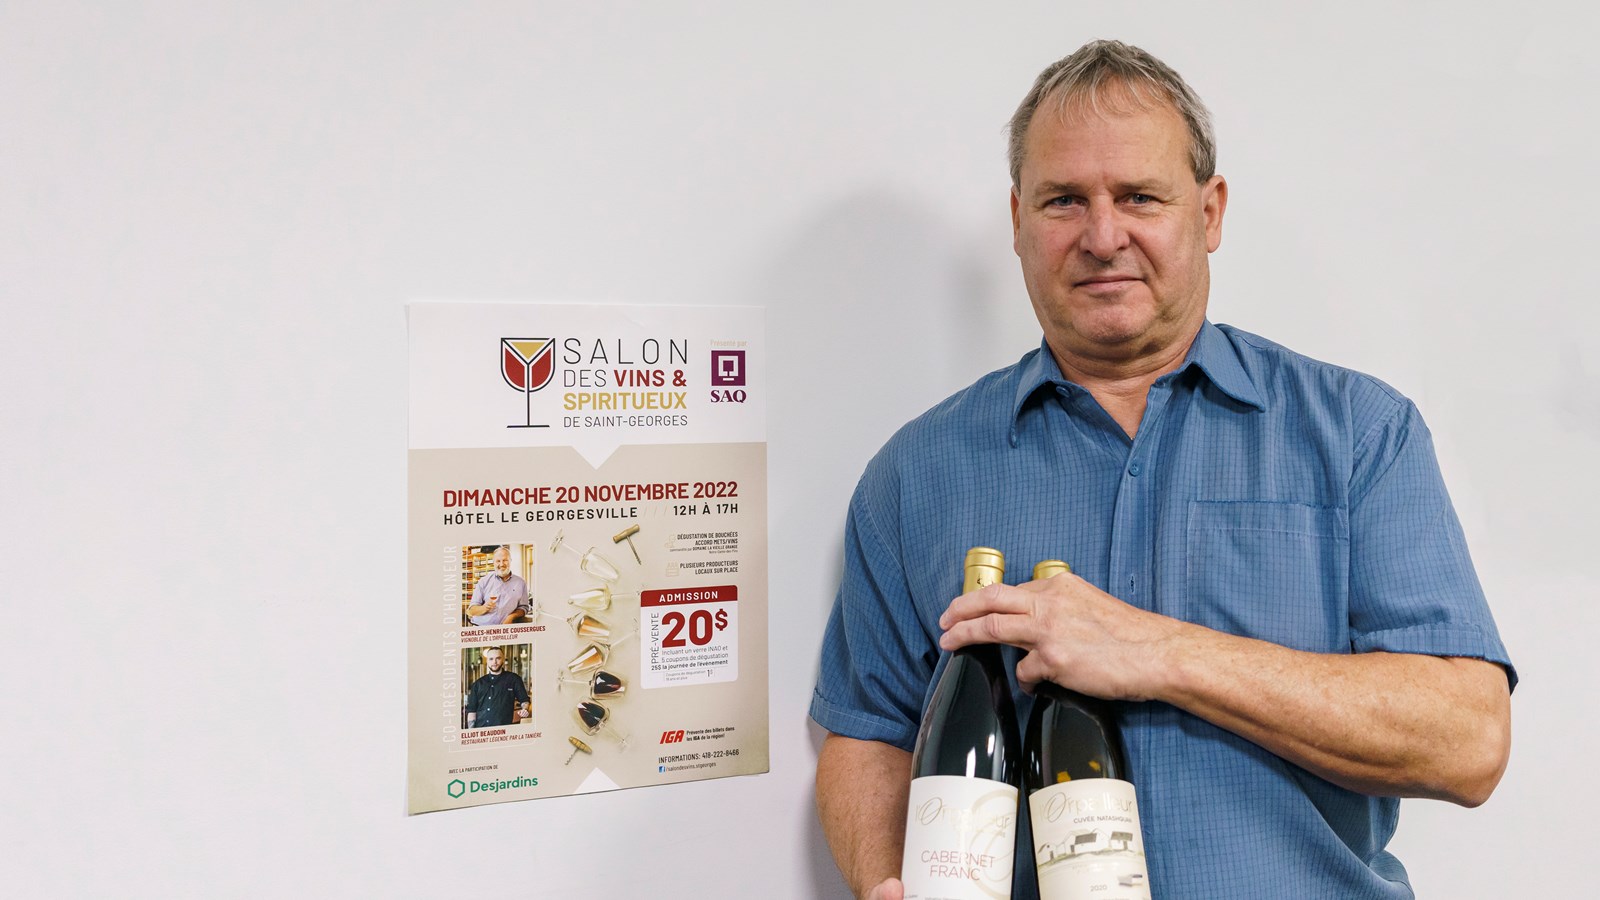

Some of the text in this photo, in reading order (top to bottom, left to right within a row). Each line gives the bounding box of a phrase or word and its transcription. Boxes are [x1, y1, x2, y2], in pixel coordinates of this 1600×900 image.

[563, 337, 688, 365] SALON
[710, 339, 747, 348] Présenté par
[563, 369, 687, 388] DES VINS &
[563, 391, 688, 411] SPIRITUEUX
[710, 389, 747, 404] SAQ
[563, 414, 688, 428] DE SAINT-GEORGES
[443, 481, 738, 508] DIMANCHE 20 NOVEMBRE 2022
[444, 502, 738, 525] HÔTEL LE GEORGESVILLE 12H À 17H
[677, 532, 708, 540] DÉGUSTATION
[715, 531, 739, 539] BOUCHÉES
[659, 591, 718, 603] ADMISSION
[461, 628, 501, 637] CHARLES-HENRI
[510, 625, 546, 634] COUSSERGUES
[650, 612, 659, 664] PRÉ-VENTE
[442, 545, 457, 743] CO-PRÉSIDENTS D'HONNEUR
[697, 652, 729, 660] dégustation
[667, 662, 689, 671] journée
[461, 729, 506, 739] ELLIOT BEAUDOIN
[461, 737, 489, 745] RESTAURANT
[659, 729, 685, 744] IGA
[658, 748, 740, 764] INFORMATIONS: 418-222-8466
[470, 776, 538, 793] Desjardins
[1073, 815, 1095, 824] CUVÉE
[921, 850, 996, 868] CABERNET
[929, 865, 981, 881] FRANC
[1090, 884, 1108, 892] 2020
